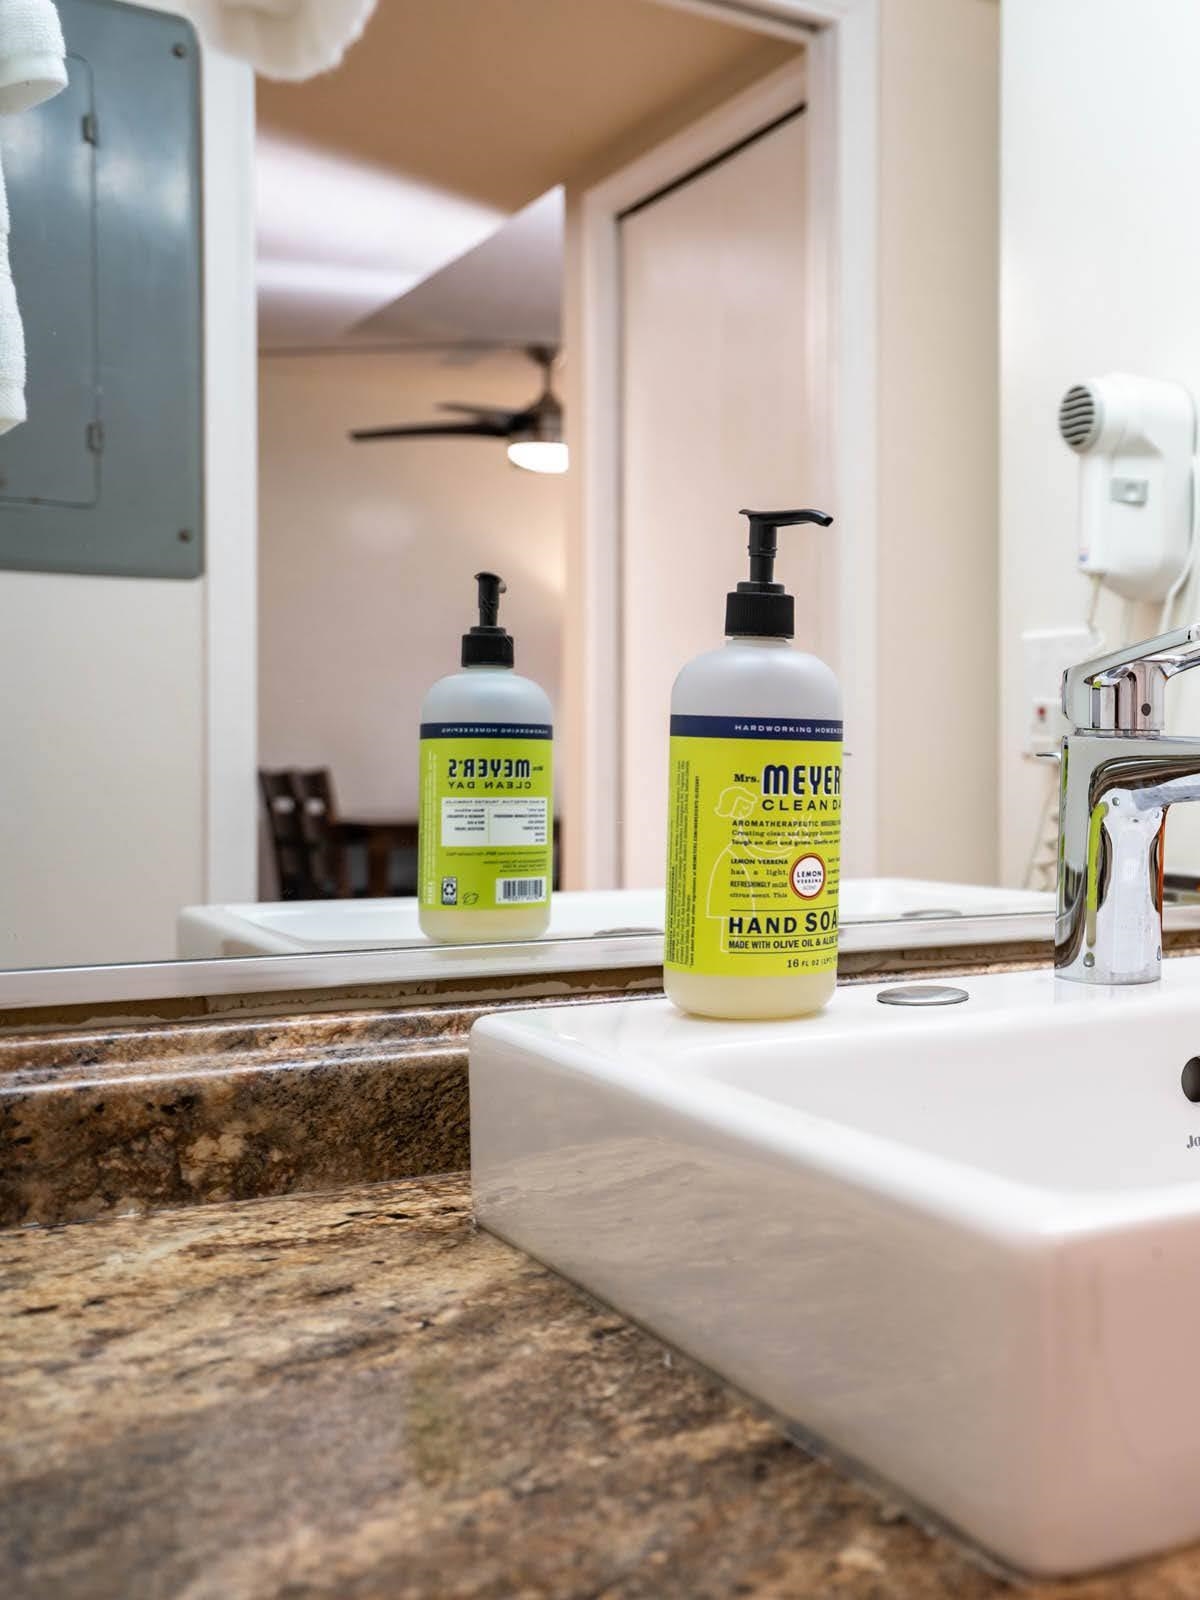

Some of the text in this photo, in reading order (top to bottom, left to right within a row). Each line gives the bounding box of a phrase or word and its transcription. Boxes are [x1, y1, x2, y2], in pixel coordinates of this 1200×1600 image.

[734, 724, 812, 734] HARDWORKING
[733, 773, 760, 783] Mrs.
[761, 799, 828, 811] CLEAN
[732, 820, 819, 828] AROMATHERAPEUTIC
[797, 870, 822, 878] LEMON
[728, 916, 797, 934] HAND
[728, 940, 749, 949] MADE
[751, 940, 771, 949] WITH
[772, 939, 799, 949] OLIVE
[801, 939, 814, 948] OIL
[815, 938, 821, 946] &
[787, 958, 800, 968] 16
